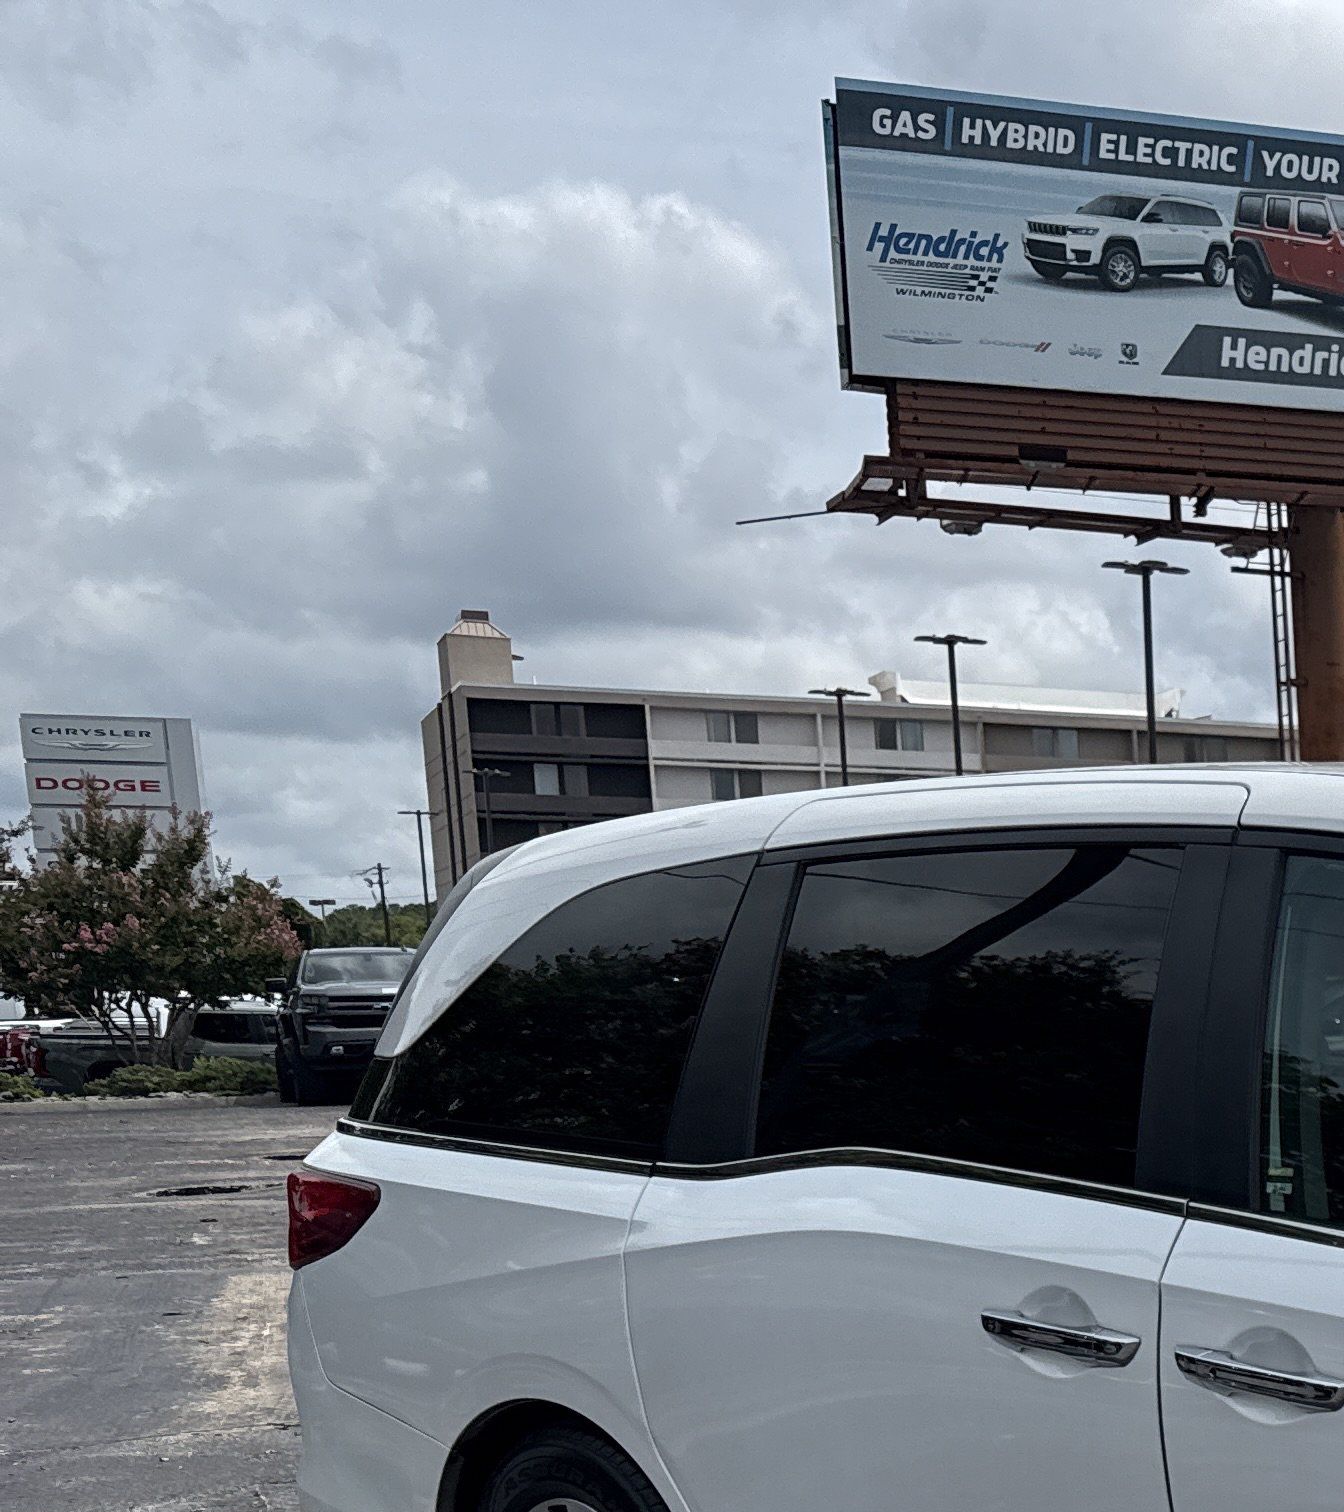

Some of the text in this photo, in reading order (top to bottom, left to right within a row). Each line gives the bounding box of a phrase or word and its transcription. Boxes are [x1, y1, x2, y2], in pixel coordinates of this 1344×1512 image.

[871, 108, 937, 140] GAS
[960, 117, 1075, 155] HYBRID
[1099, 133, 1238, 173] ELECTRIC
[1261, 150, 1339, 184] YOUR
[866, 222, 1009, 263] Hendrick
[889, 257, 925, 267] CHRYSLER
[926, 260, 951, 270] DODGE
[950, 263, 969, 271] JEEP
[895, 287, 986, 302] WILMINGTON
[31, 727, 152, 738] CHRYSLER
[35, 777, 161, 792] DODGE
